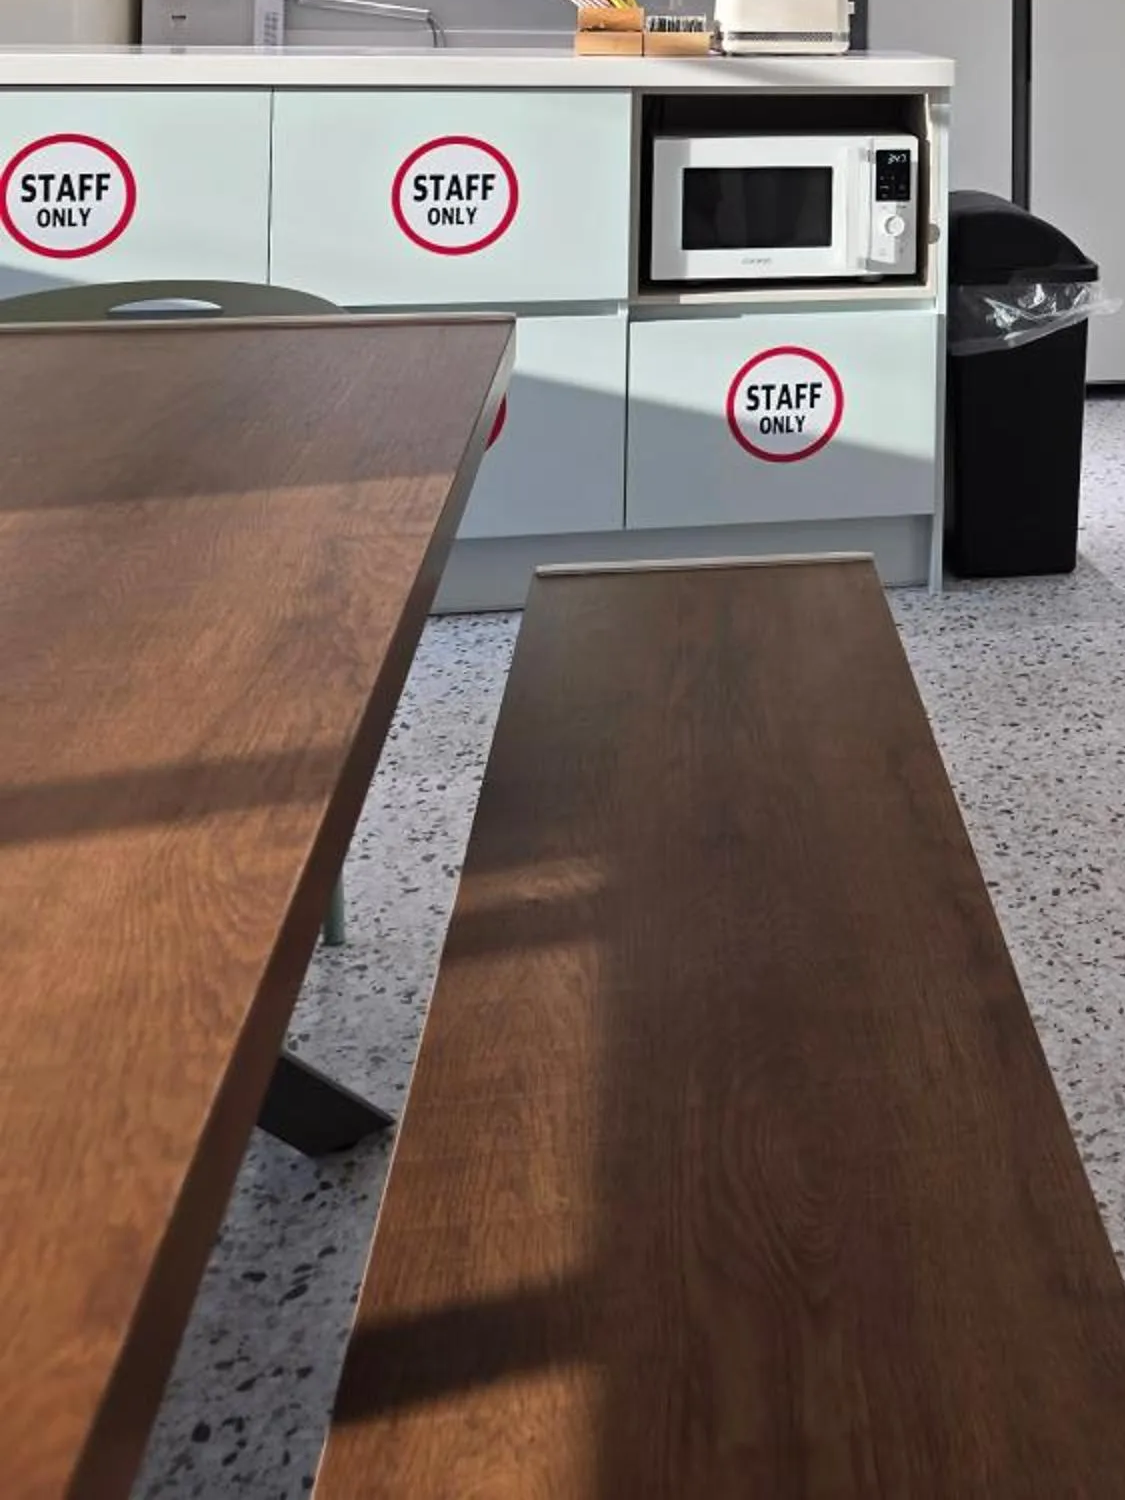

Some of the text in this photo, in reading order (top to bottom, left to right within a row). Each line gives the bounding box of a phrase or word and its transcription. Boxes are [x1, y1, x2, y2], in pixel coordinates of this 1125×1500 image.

[20, 173, 111, 203] STAFF
[413, 173, 496, 202] STAFF
[36, 208, 91, 228] ONLY
[427, 207, 477, 226] ONLY
[746, 382, 822, 411] STAFF
[760, 415, 805, 434] ONLY
